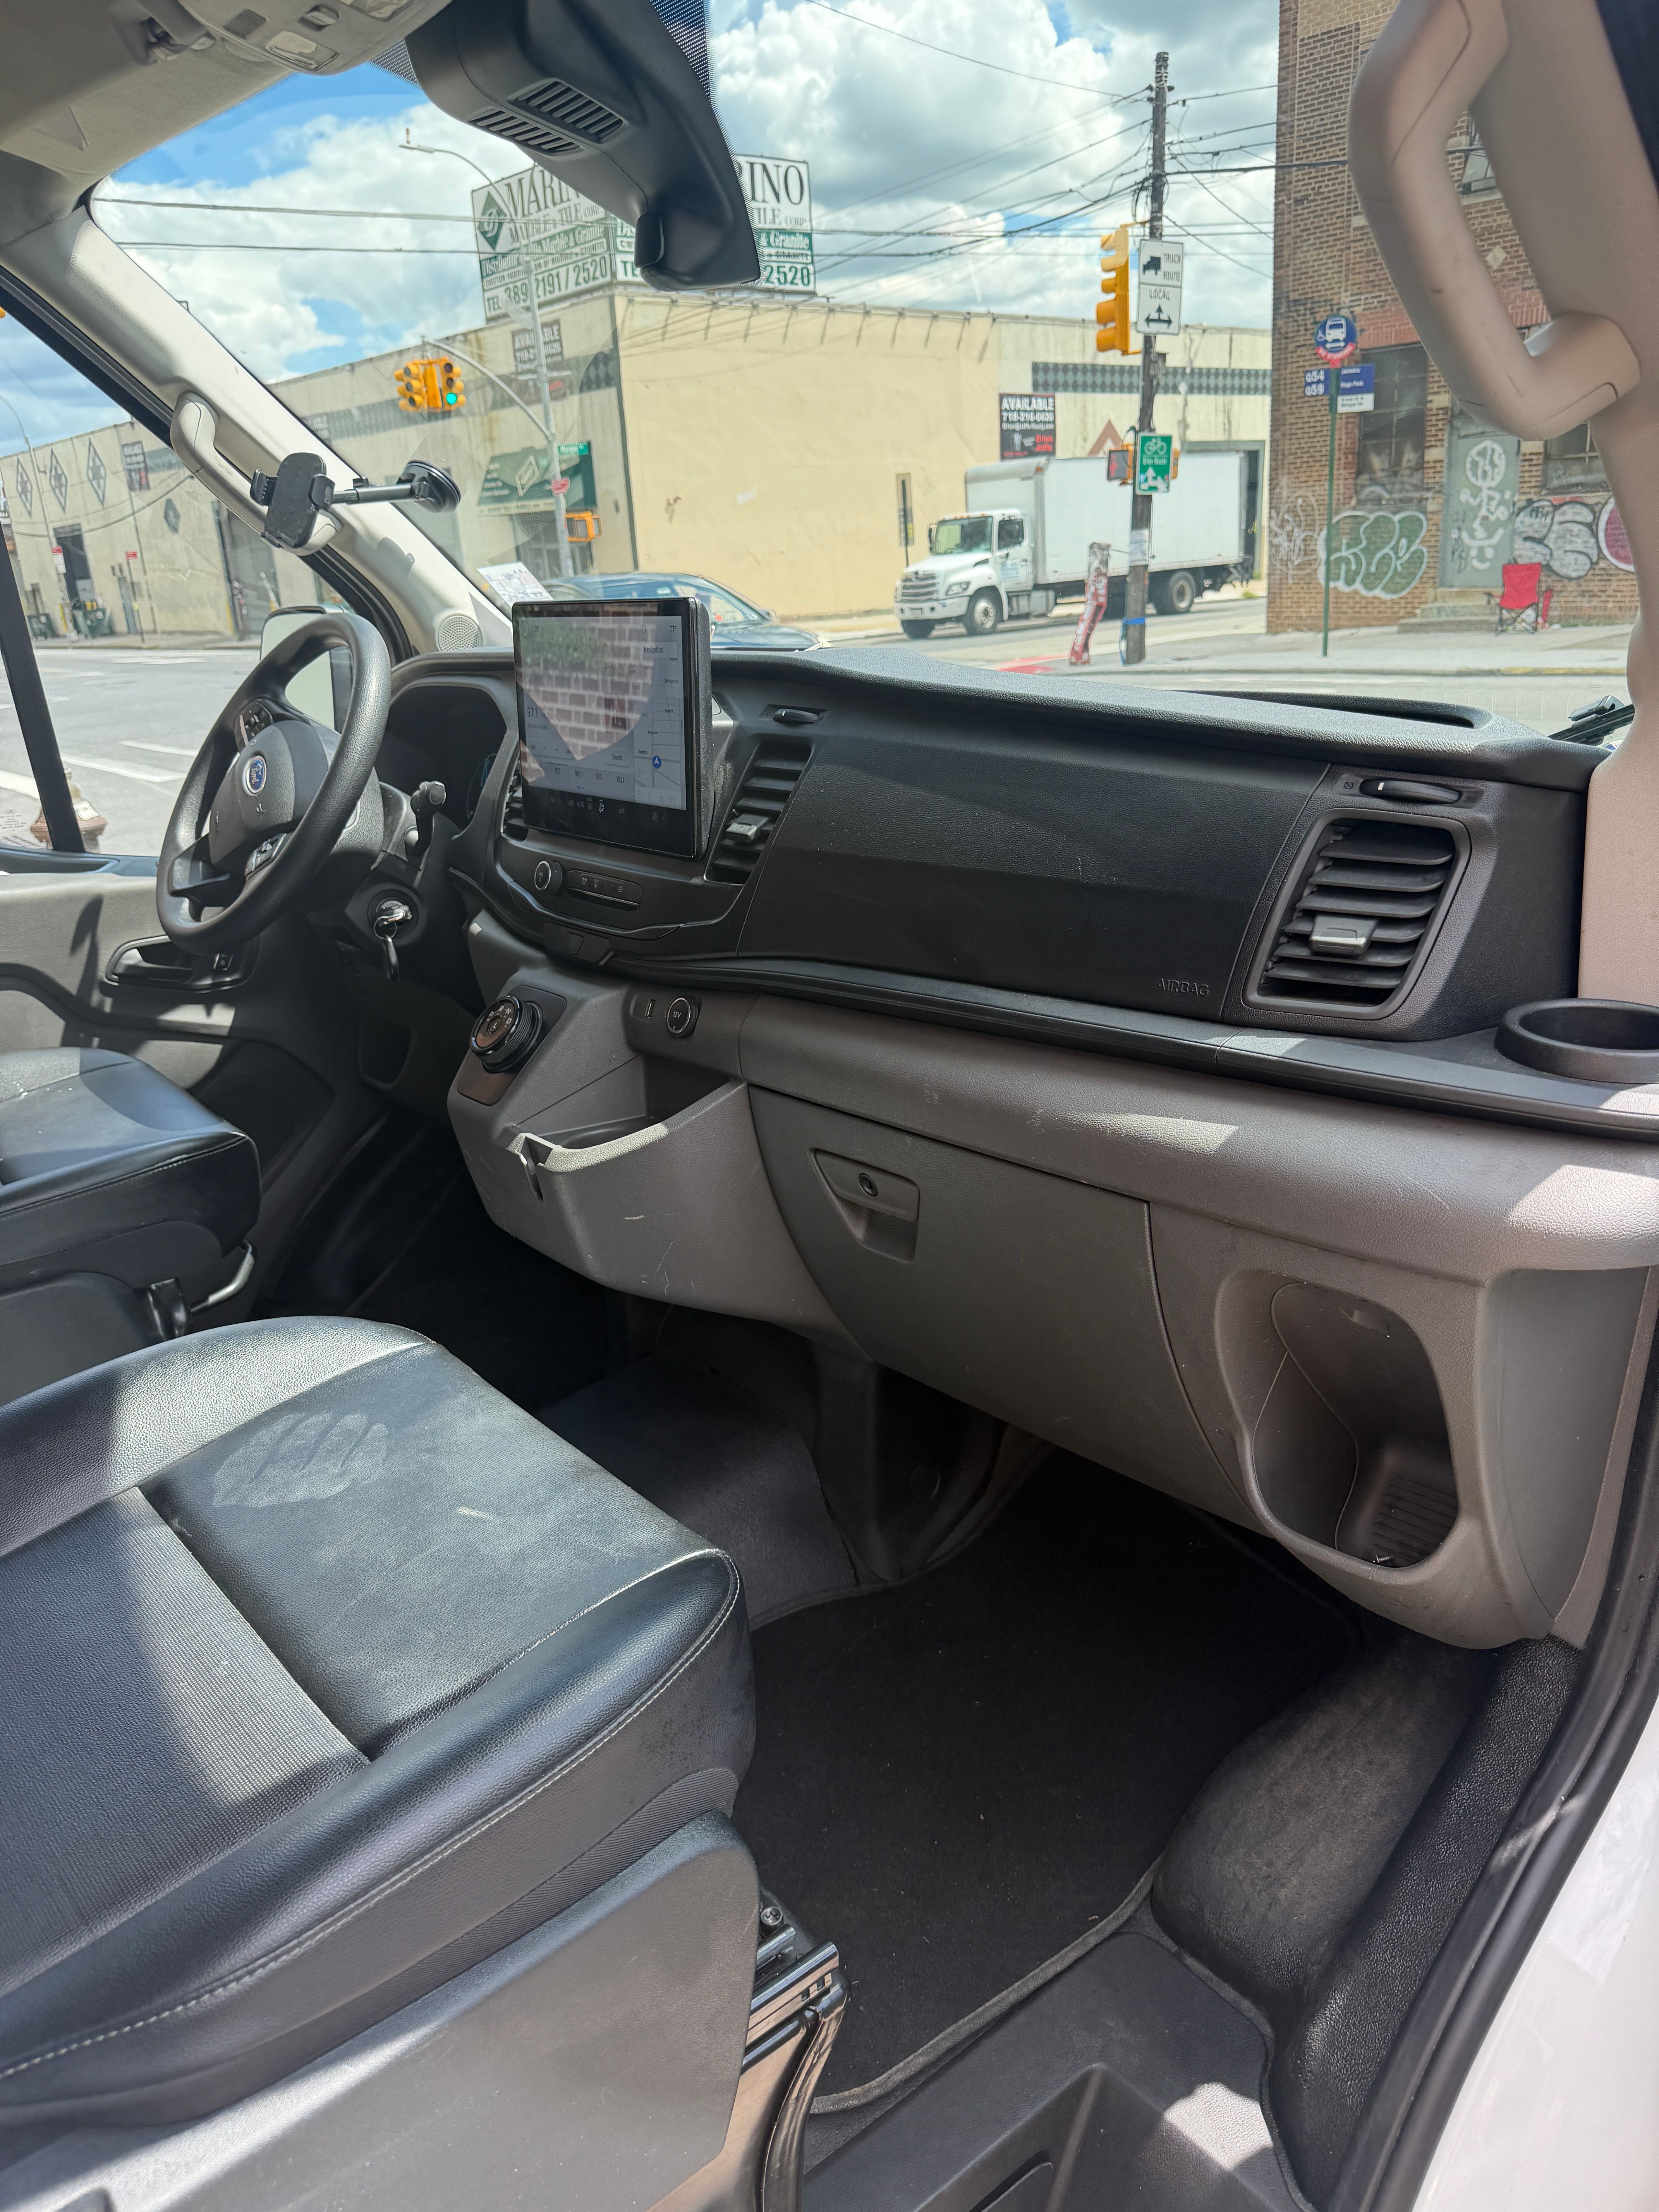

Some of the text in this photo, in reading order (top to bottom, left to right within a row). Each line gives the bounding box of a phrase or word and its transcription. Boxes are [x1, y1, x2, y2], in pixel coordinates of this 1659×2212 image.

[738, 162, 804, 204] INO
[766, 265, 811, 287] 2520
[1001, 397, 1054, 410] AVAILABLE
[527, 707, 538, 718] 97.1
[1156, 979, 1209, 995] AIRBAG
